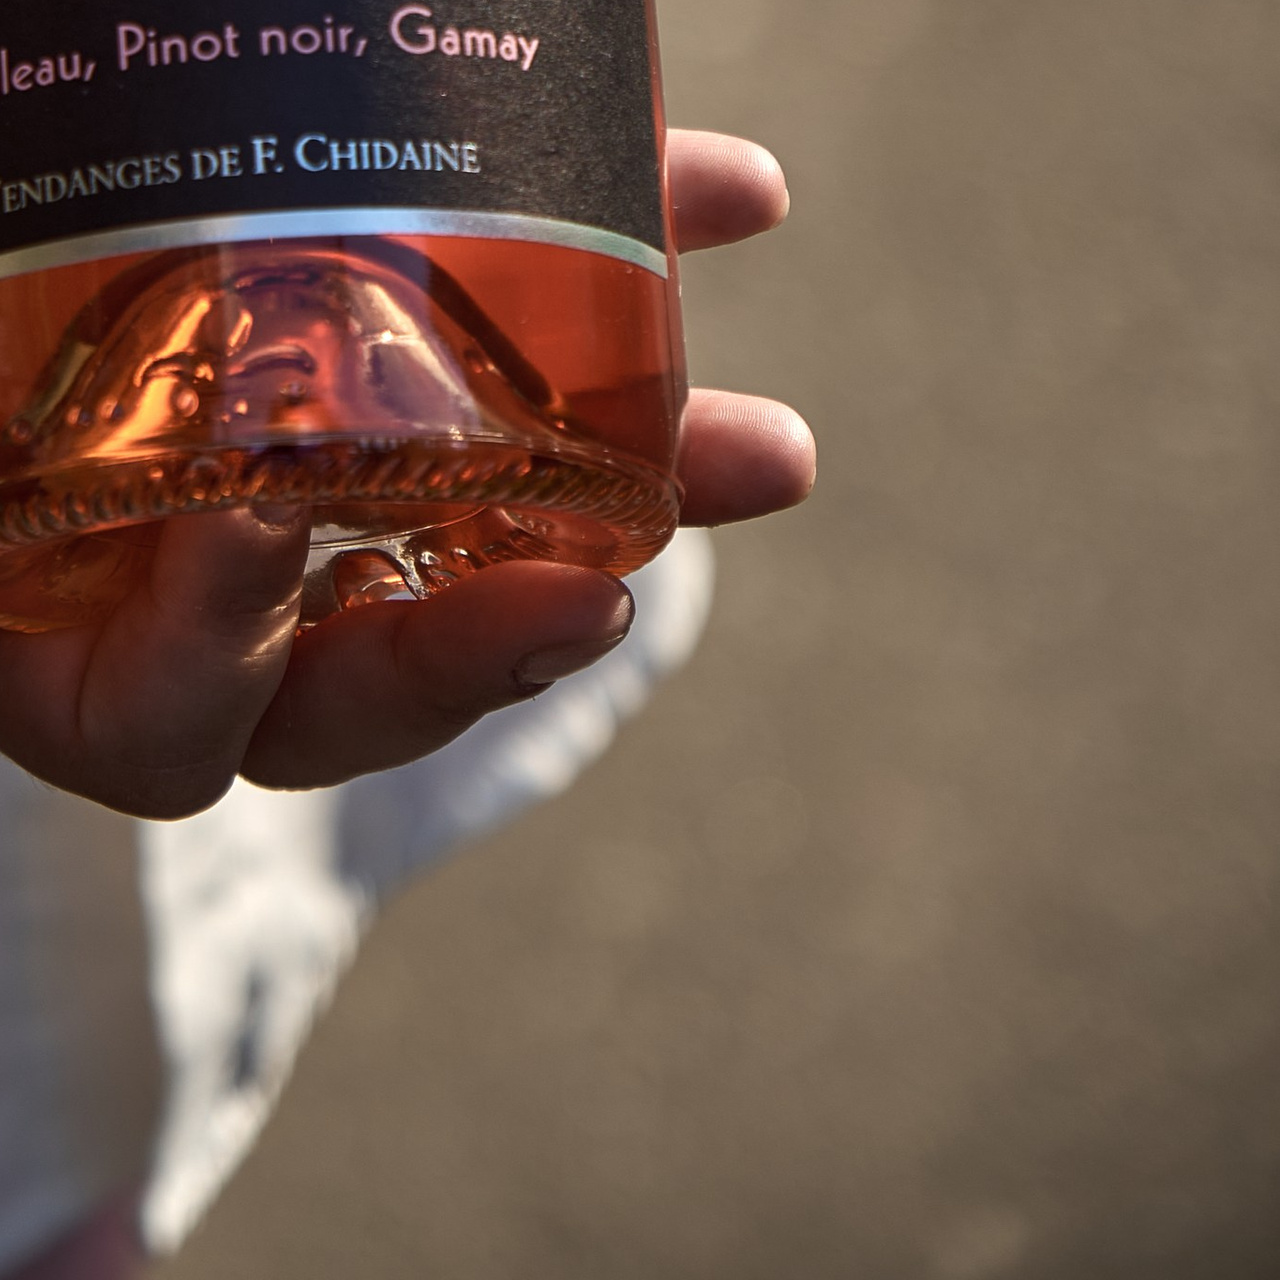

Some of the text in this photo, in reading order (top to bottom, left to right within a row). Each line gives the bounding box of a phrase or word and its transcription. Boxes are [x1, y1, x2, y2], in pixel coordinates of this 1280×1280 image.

[117, 22, 240, 71] Pinot
[260, 15, 368, 57] noir,
[390, 4, 539, 72] Gamay
[191, 146, 242, 180] DE
[251, 136, 284, 175] F.
[294, 134, 481, 174] CHIDAINE
